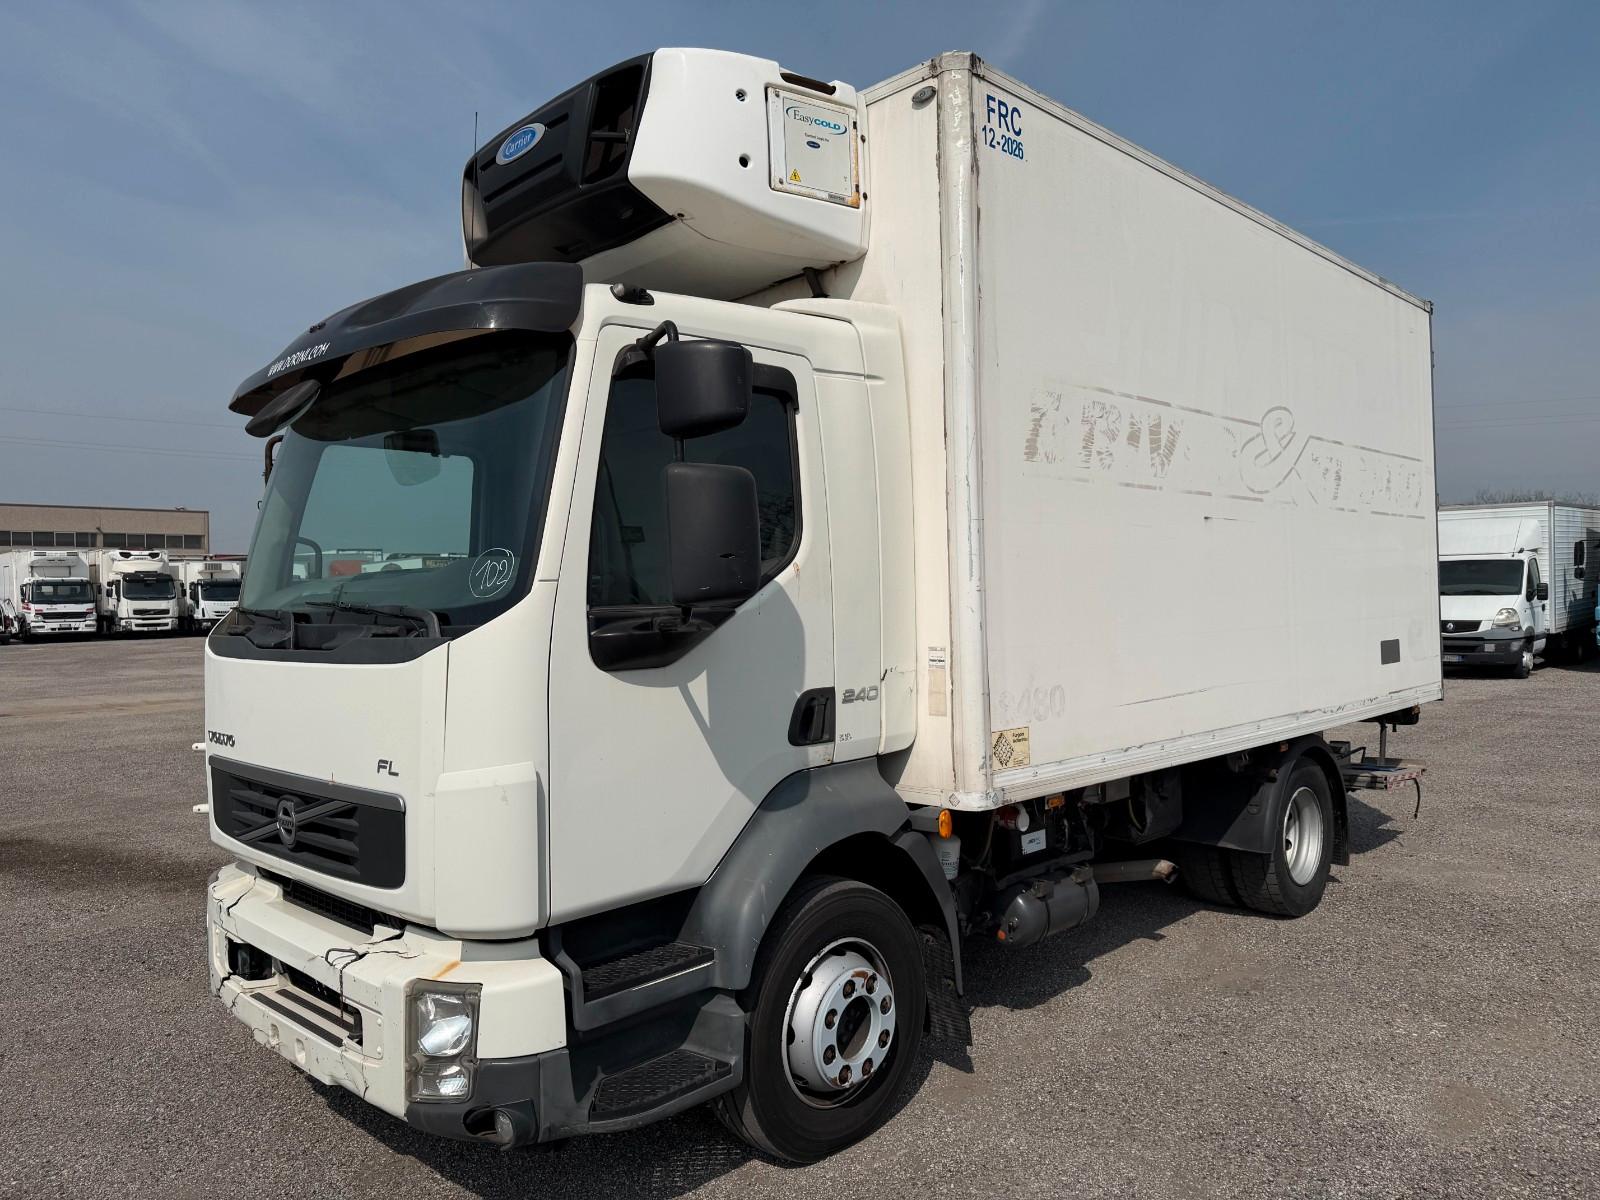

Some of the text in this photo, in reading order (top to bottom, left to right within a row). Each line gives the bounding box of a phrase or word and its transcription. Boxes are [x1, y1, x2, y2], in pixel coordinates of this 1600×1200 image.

[793, 109, 841, 130] EasyCOLD
[986, 93, 1022, 137] FRC
[505, 132, 532, 155] Carrier
[981, 124, 1024, 160] 12-2026
[475, 559, 508, 590] 102
[841, 685, 879, 704] 240
[207, 730, 236, 748] VOLVO
[376, 759, 400, 777] FL
